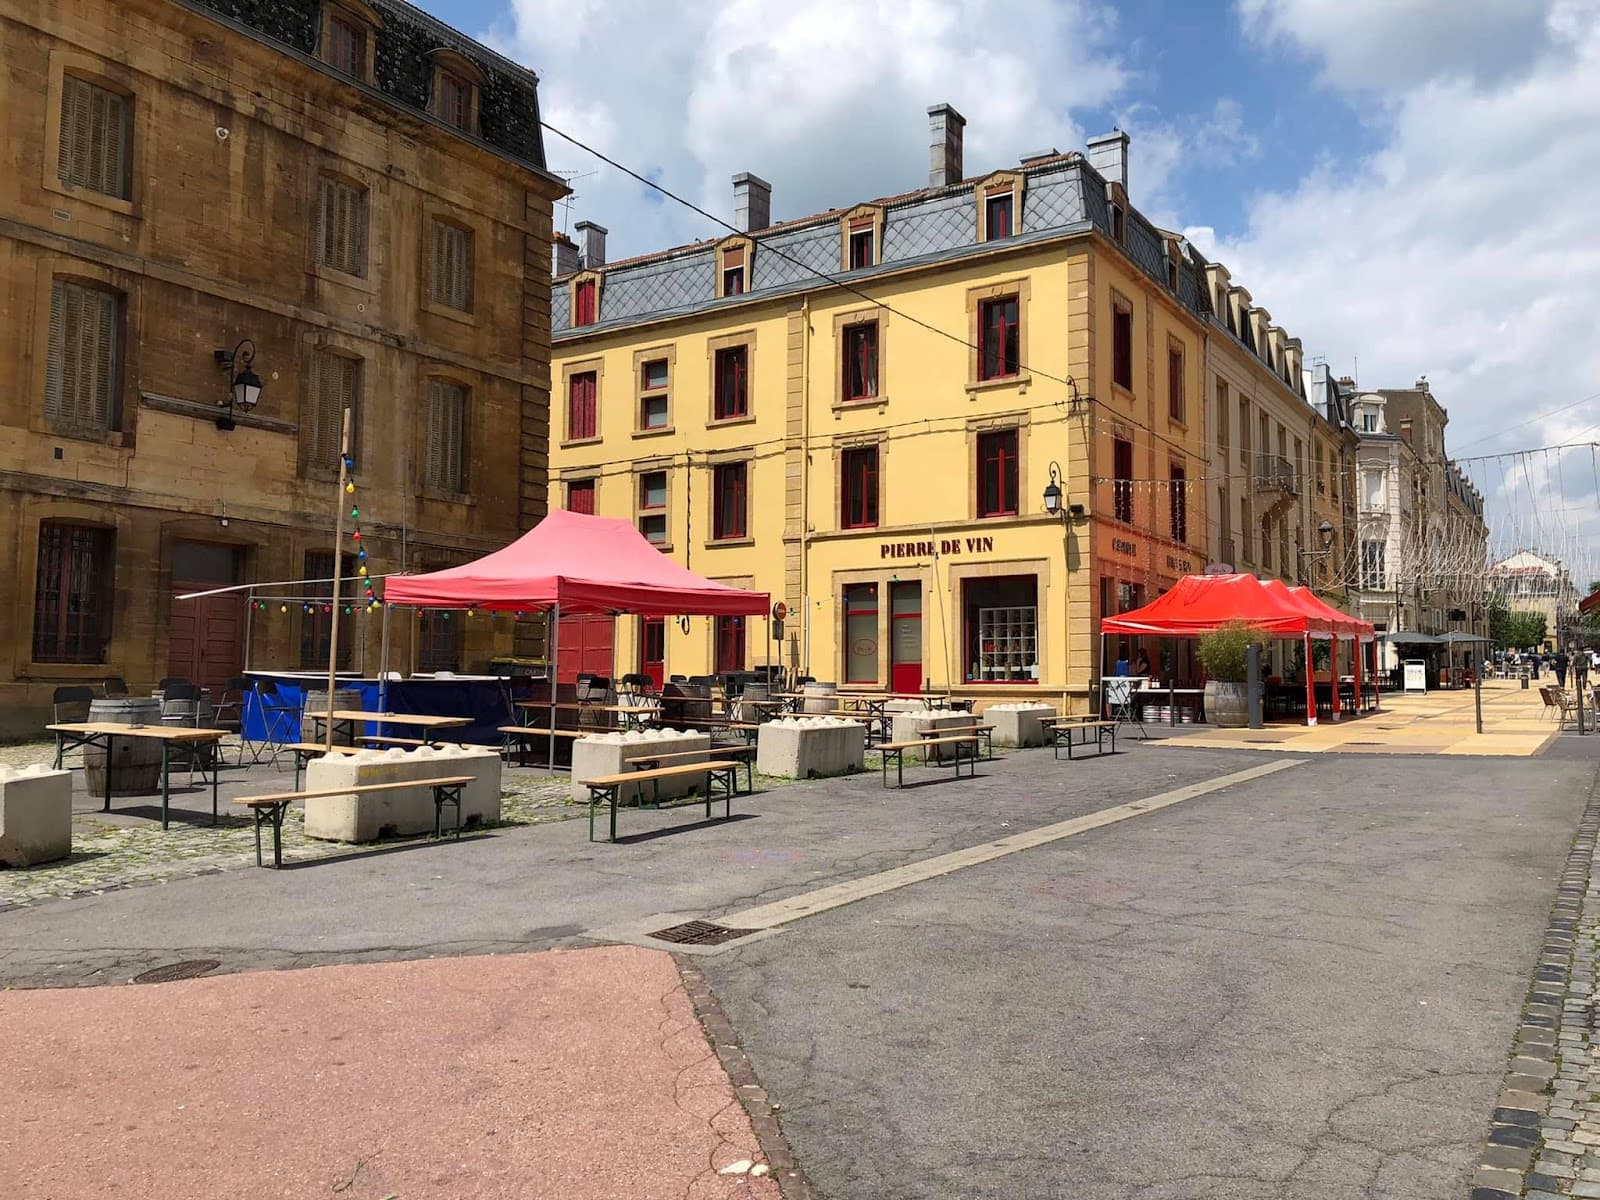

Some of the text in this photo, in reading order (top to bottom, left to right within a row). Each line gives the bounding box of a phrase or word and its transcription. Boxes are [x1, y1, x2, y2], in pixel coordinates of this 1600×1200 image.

[880, 536, 993, 559] PIERRE DE VIN
